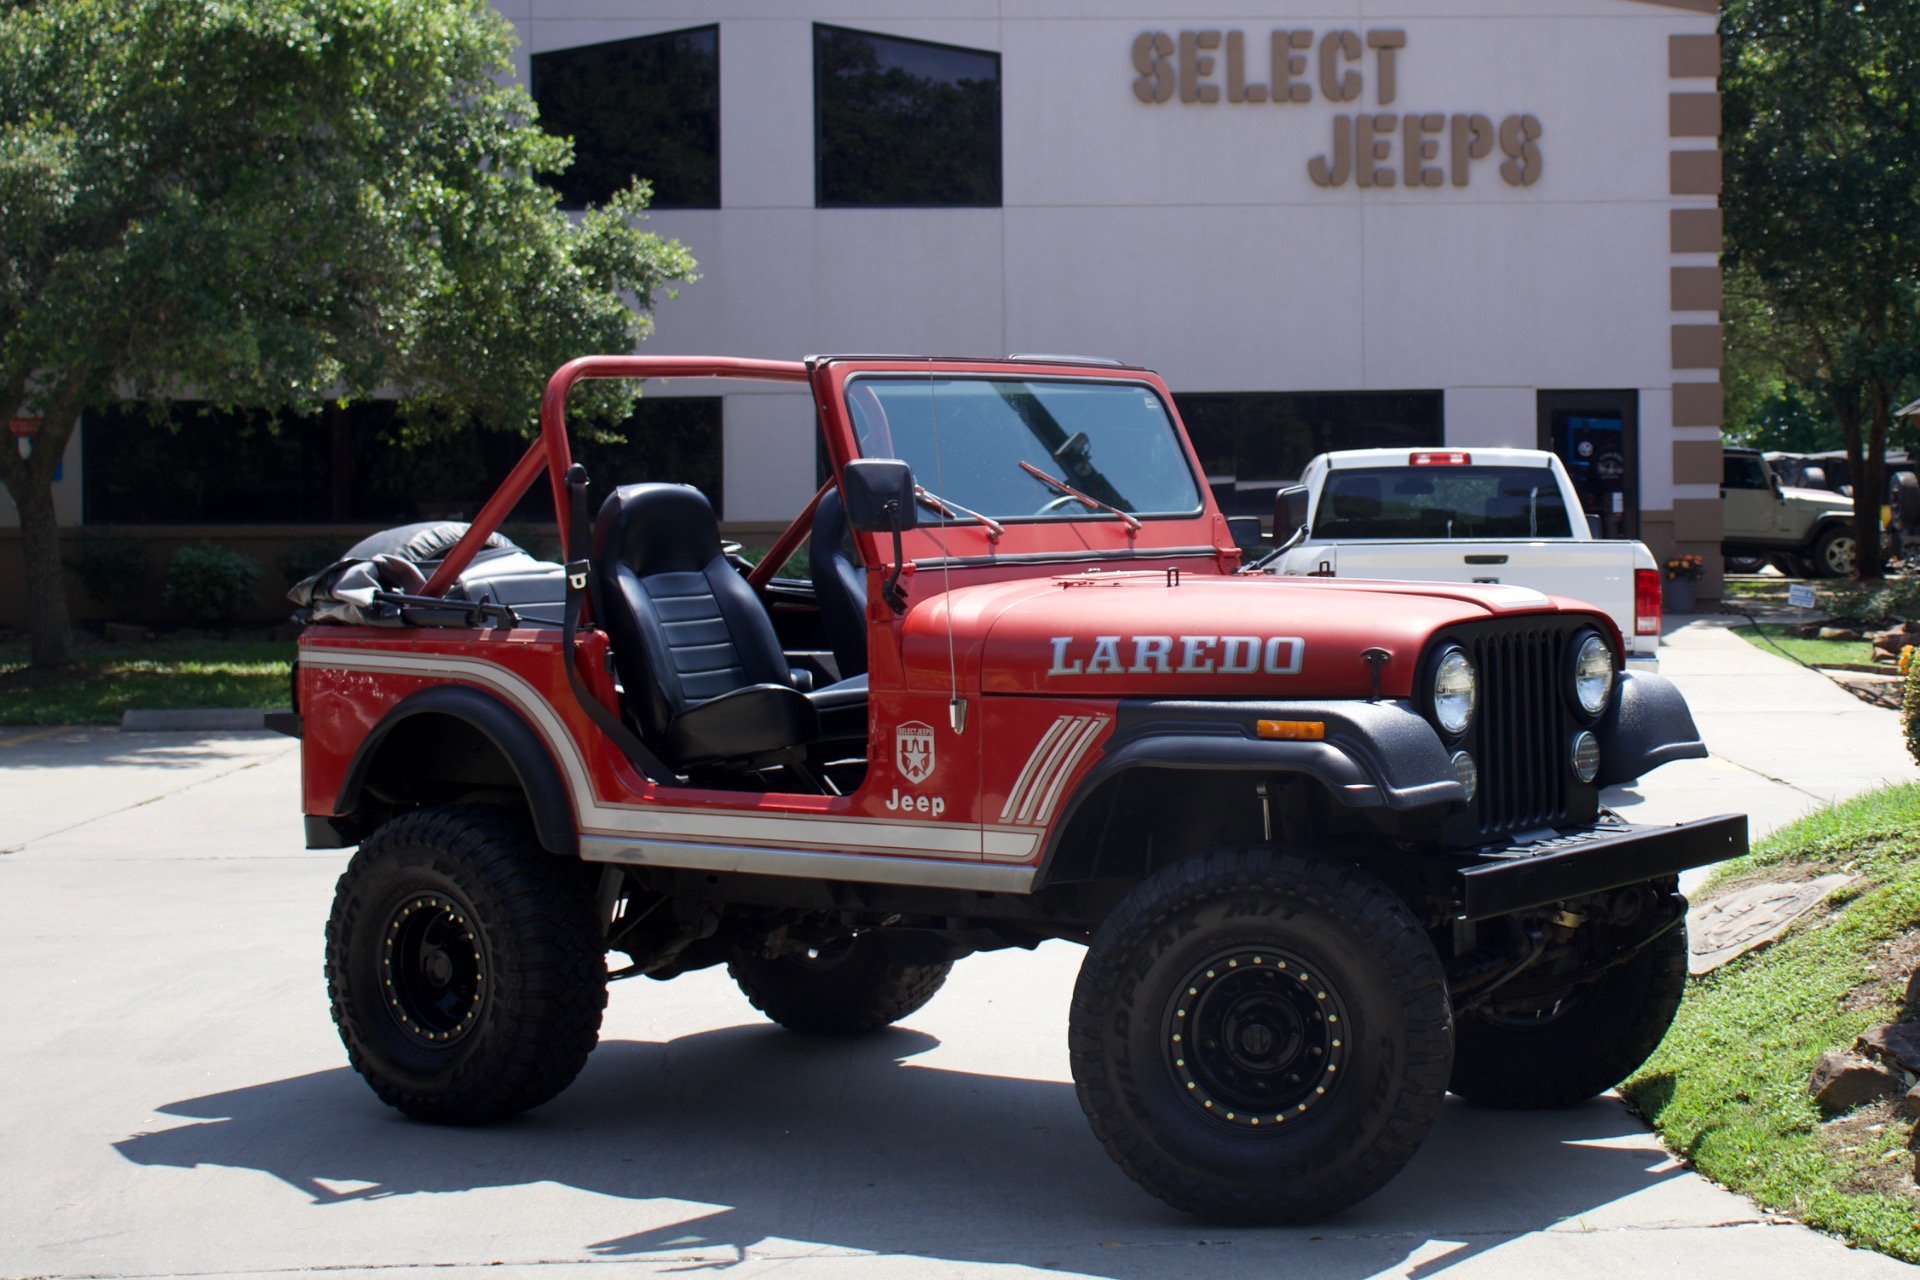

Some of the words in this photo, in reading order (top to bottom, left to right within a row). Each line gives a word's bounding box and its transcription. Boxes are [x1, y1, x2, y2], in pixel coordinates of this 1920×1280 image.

[1131, 29, 1406, 105] SELECT
[1307, 114, 1543, 188] JEEPS
[1047, 635, 1306, 676] LAREDO
[898, 727, 916, 735] SELECT
[917, 727, 933, 736] JEEPS
[885, 788, 945, 817] Jeep
[1114, 913, 1202, 1122] WILDPEAK
[1222, 901, 1304, 921] M/T
